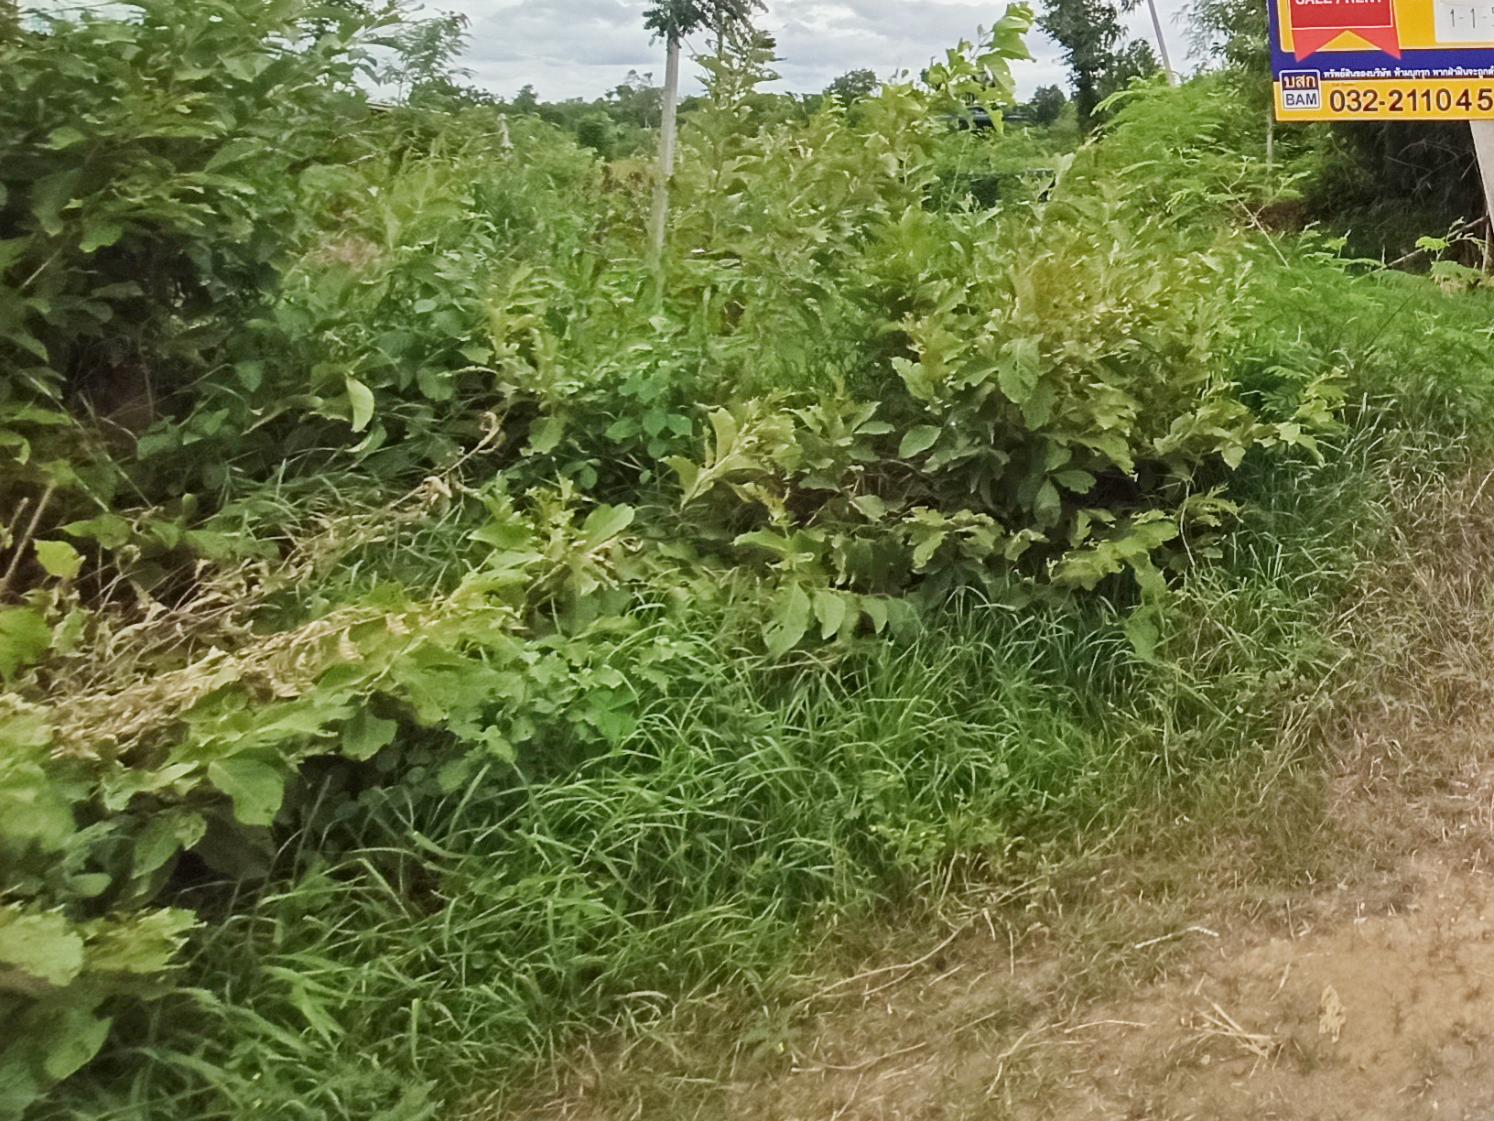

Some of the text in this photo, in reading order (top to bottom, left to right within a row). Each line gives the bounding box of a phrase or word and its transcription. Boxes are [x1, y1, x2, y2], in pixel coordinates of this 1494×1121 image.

[1283, 75, 1316, 89] บสก
[1285, 92, 1317, 106] BAM
[1329, 88, 1494, 112] 032-211045
